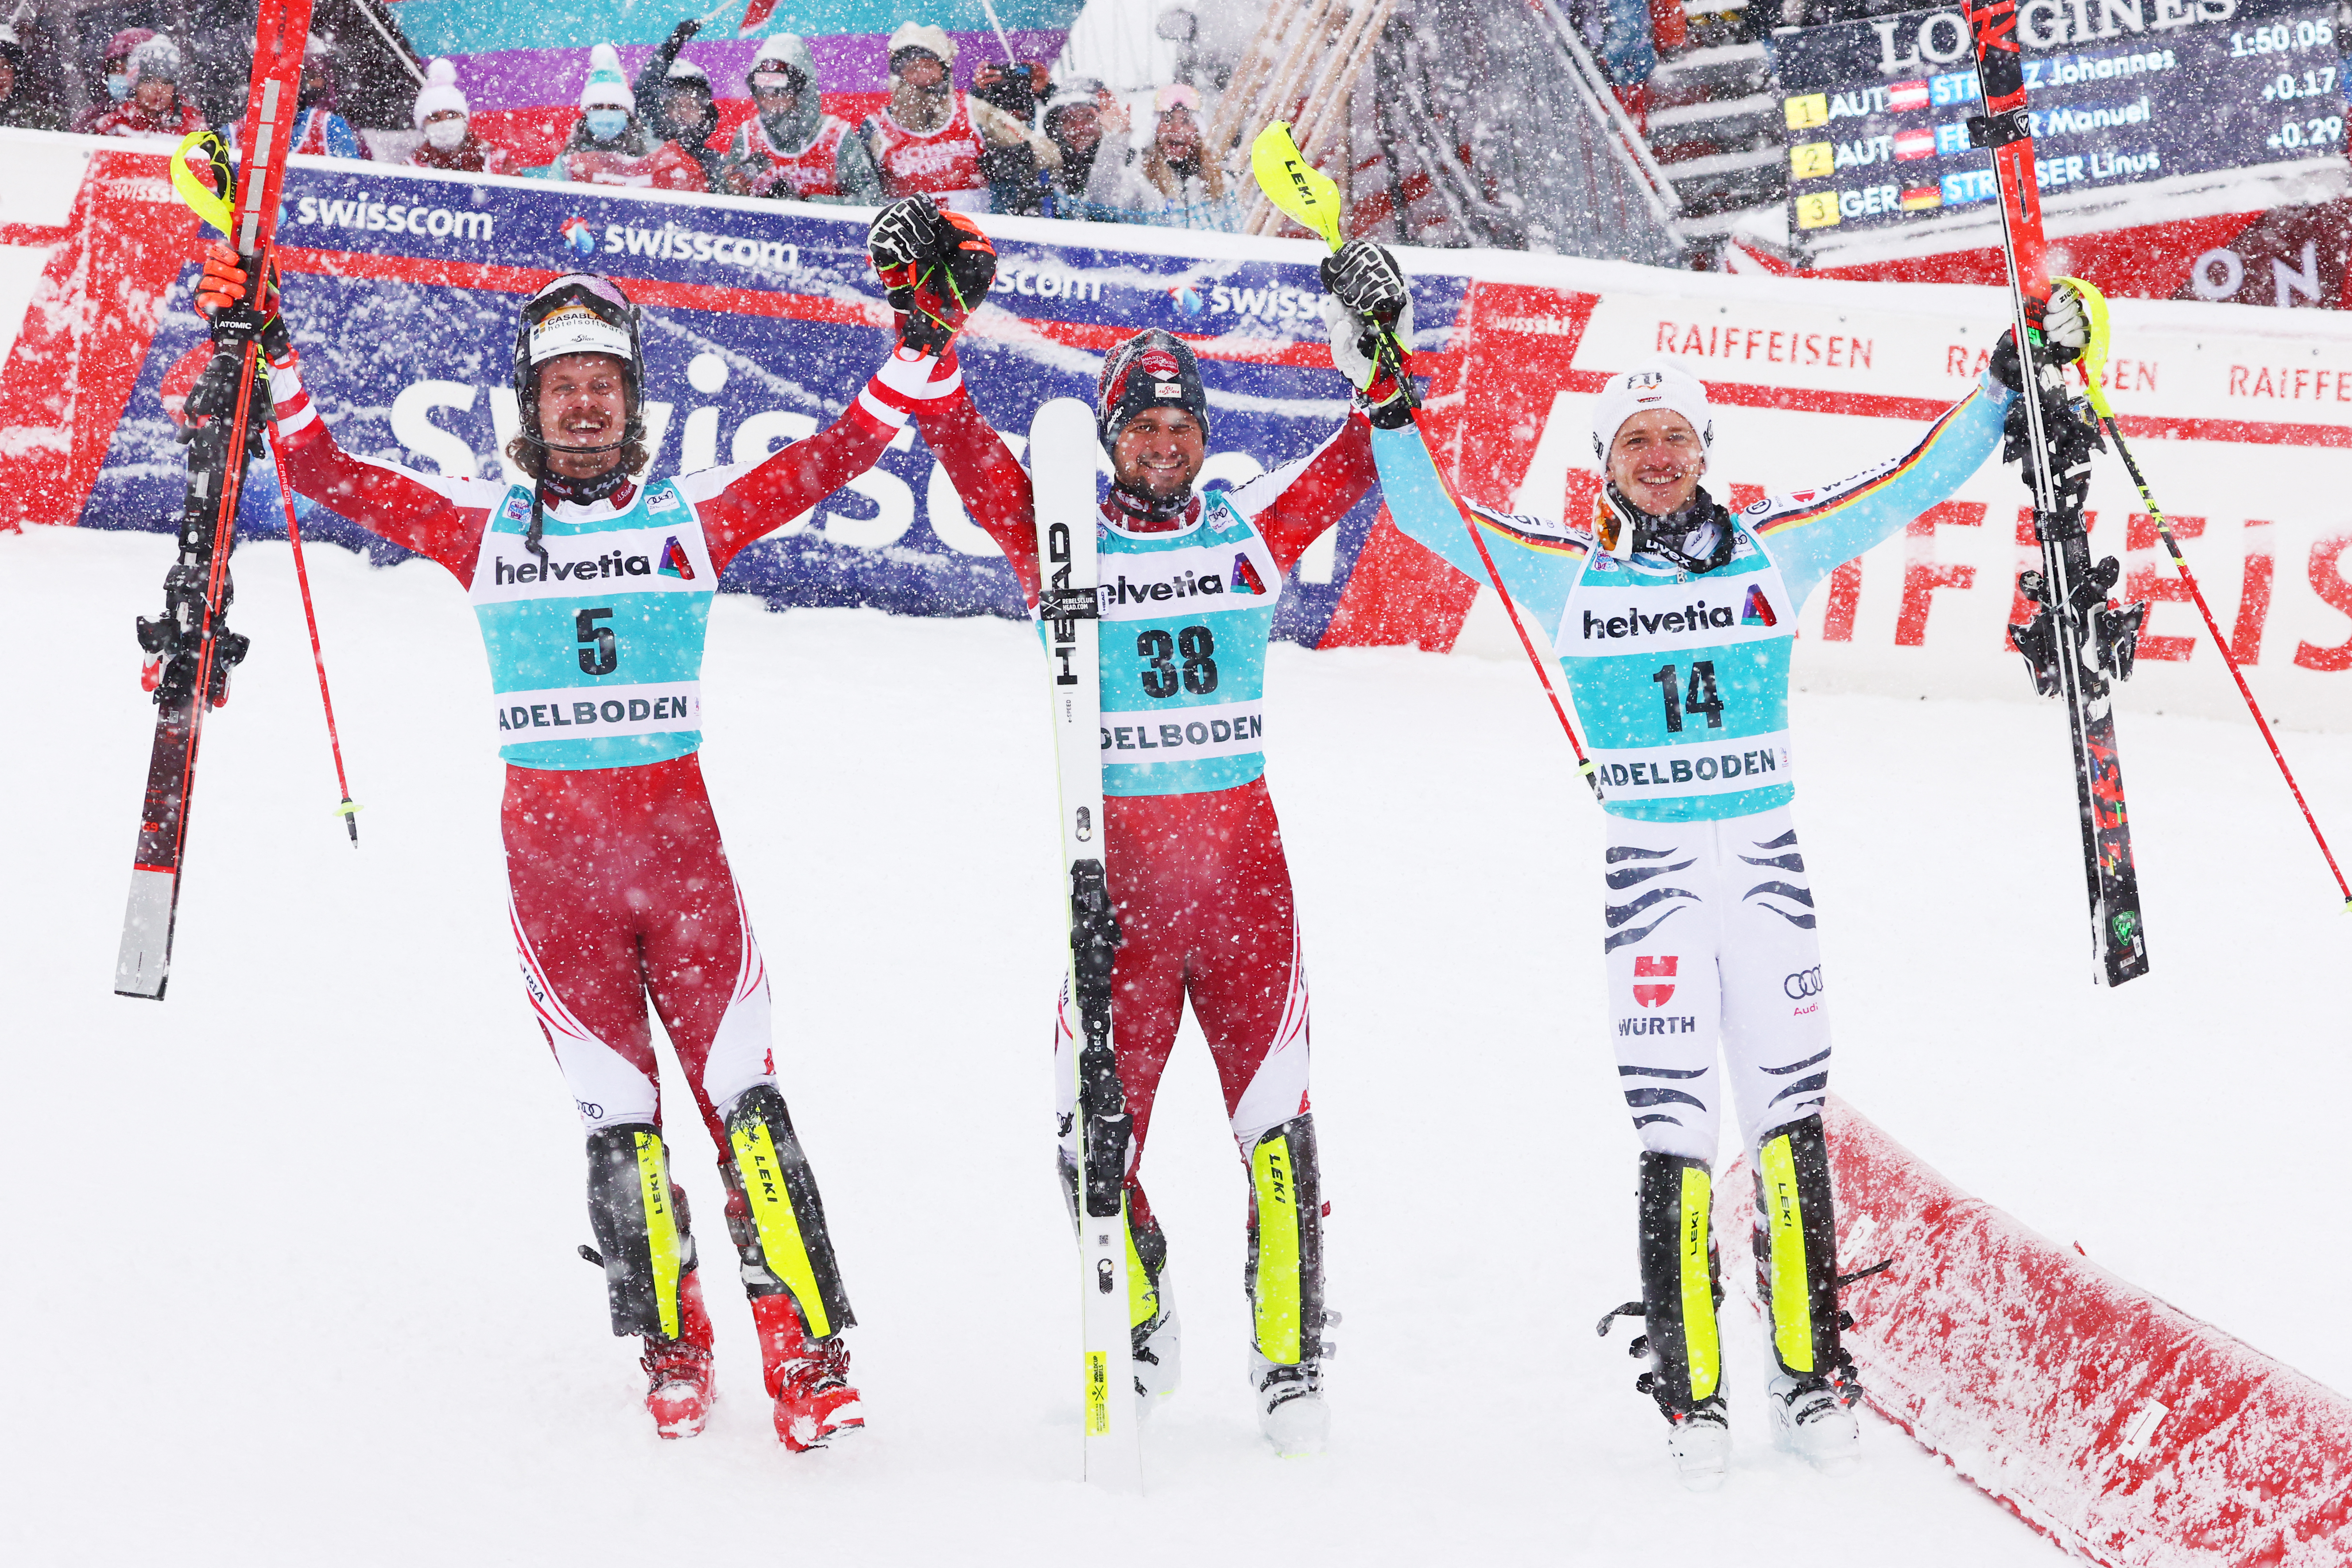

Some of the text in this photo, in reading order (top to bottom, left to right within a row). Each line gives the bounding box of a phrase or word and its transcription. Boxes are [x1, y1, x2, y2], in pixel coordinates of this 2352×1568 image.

[1872, 0, 2236, 74] LOGINES
[1829, 87, 1886, 120] AUT
[1934, 62, 2044, 105] STRZ
[2050, 49, 2175, 86] Johannes
[1806, 66, 2337, 173] 2 AUT FER Manuel +0.17
[1285, 160, 1317, 205] LEKI
[1811, 116, 2343, 220] 3 GER STRSER Linus +0.29
[298, 191, 493, 240] swisscom
[605, 220, 799, 271] swisscom
[1340, 240, 1359, 257] racing
[219, 321, 252, 329] ATOMIC
[548, 319, 624, 337] hotelsoftware
[1656, 321, 1873, 370] RAIFFEISEN
[1394, 372, 1406, 392] VENOM
[279, 463, 291, 504] CARBON
[2137, 485, 2170, 532] LEKI
[496, 550, 651, 585] helvetia
[1646, 539, 1692, 568] uvex
[1049, 523, 1078, 685] HEAD
[1583, 600, 1733, 640] helvetia
[576, 607, 617, 676] 5
[1137, 626, 1218, 699] 38
[499, 696, 687, 731] ADELBODEN
[1653, 660, 1724, 733] 14
[1600, 747, 1776, 787] ADELBODEN
[1618, 1016, 1695, 1037] WÜRTH
[1793, 1003, 1819, 1017] Audi
[652, 1173, 664, 1215] LEKI
[754, 1155, 778, 1203] LEKI
[1269, 1154, 1286, 1204] LEKI
[1778, 1182, 1793, 1228] LEKI
[1690, 1210, 1699, 1256] LEKI
